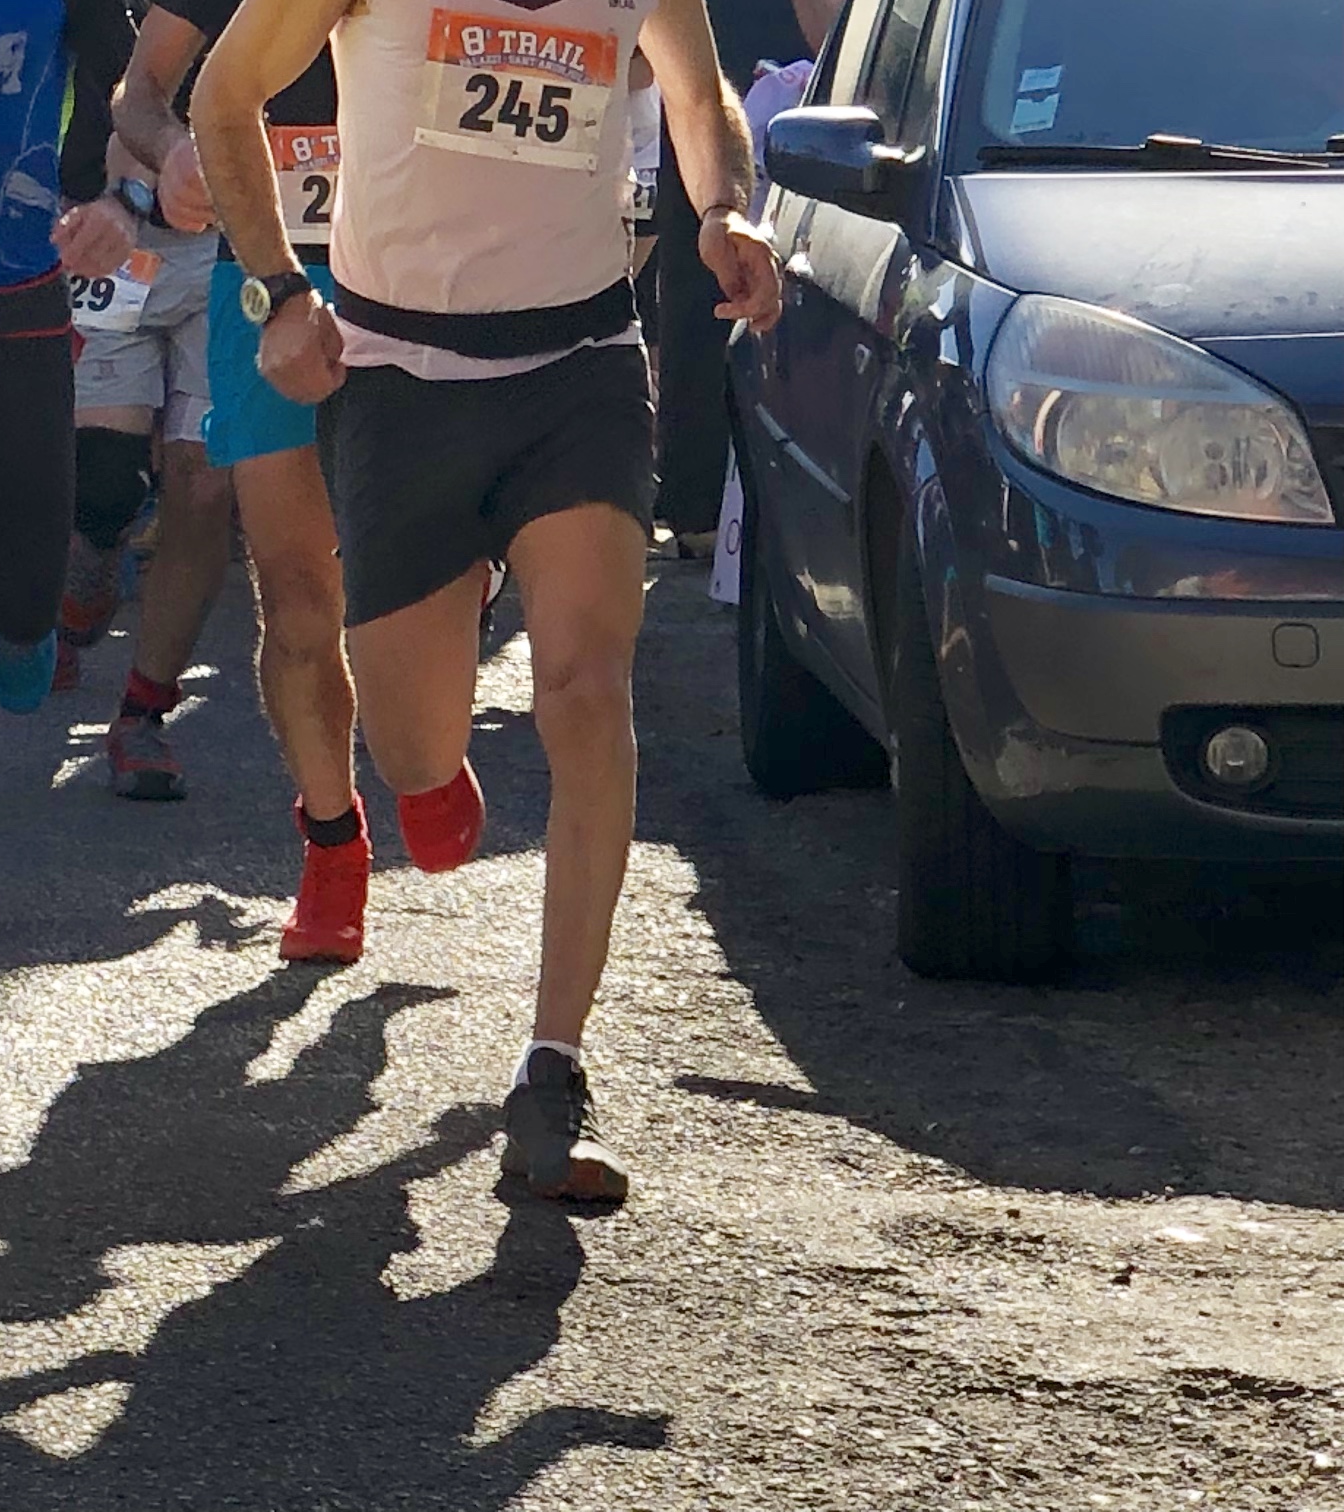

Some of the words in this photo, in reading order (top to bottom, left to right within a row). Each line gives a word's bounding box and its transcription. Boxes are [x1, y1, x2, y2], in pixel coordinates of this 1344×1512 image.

[498, 30, 584, 71] TRAIL
[459, 74, 572, 143] 245
[70, 275, 116, 312] 29
